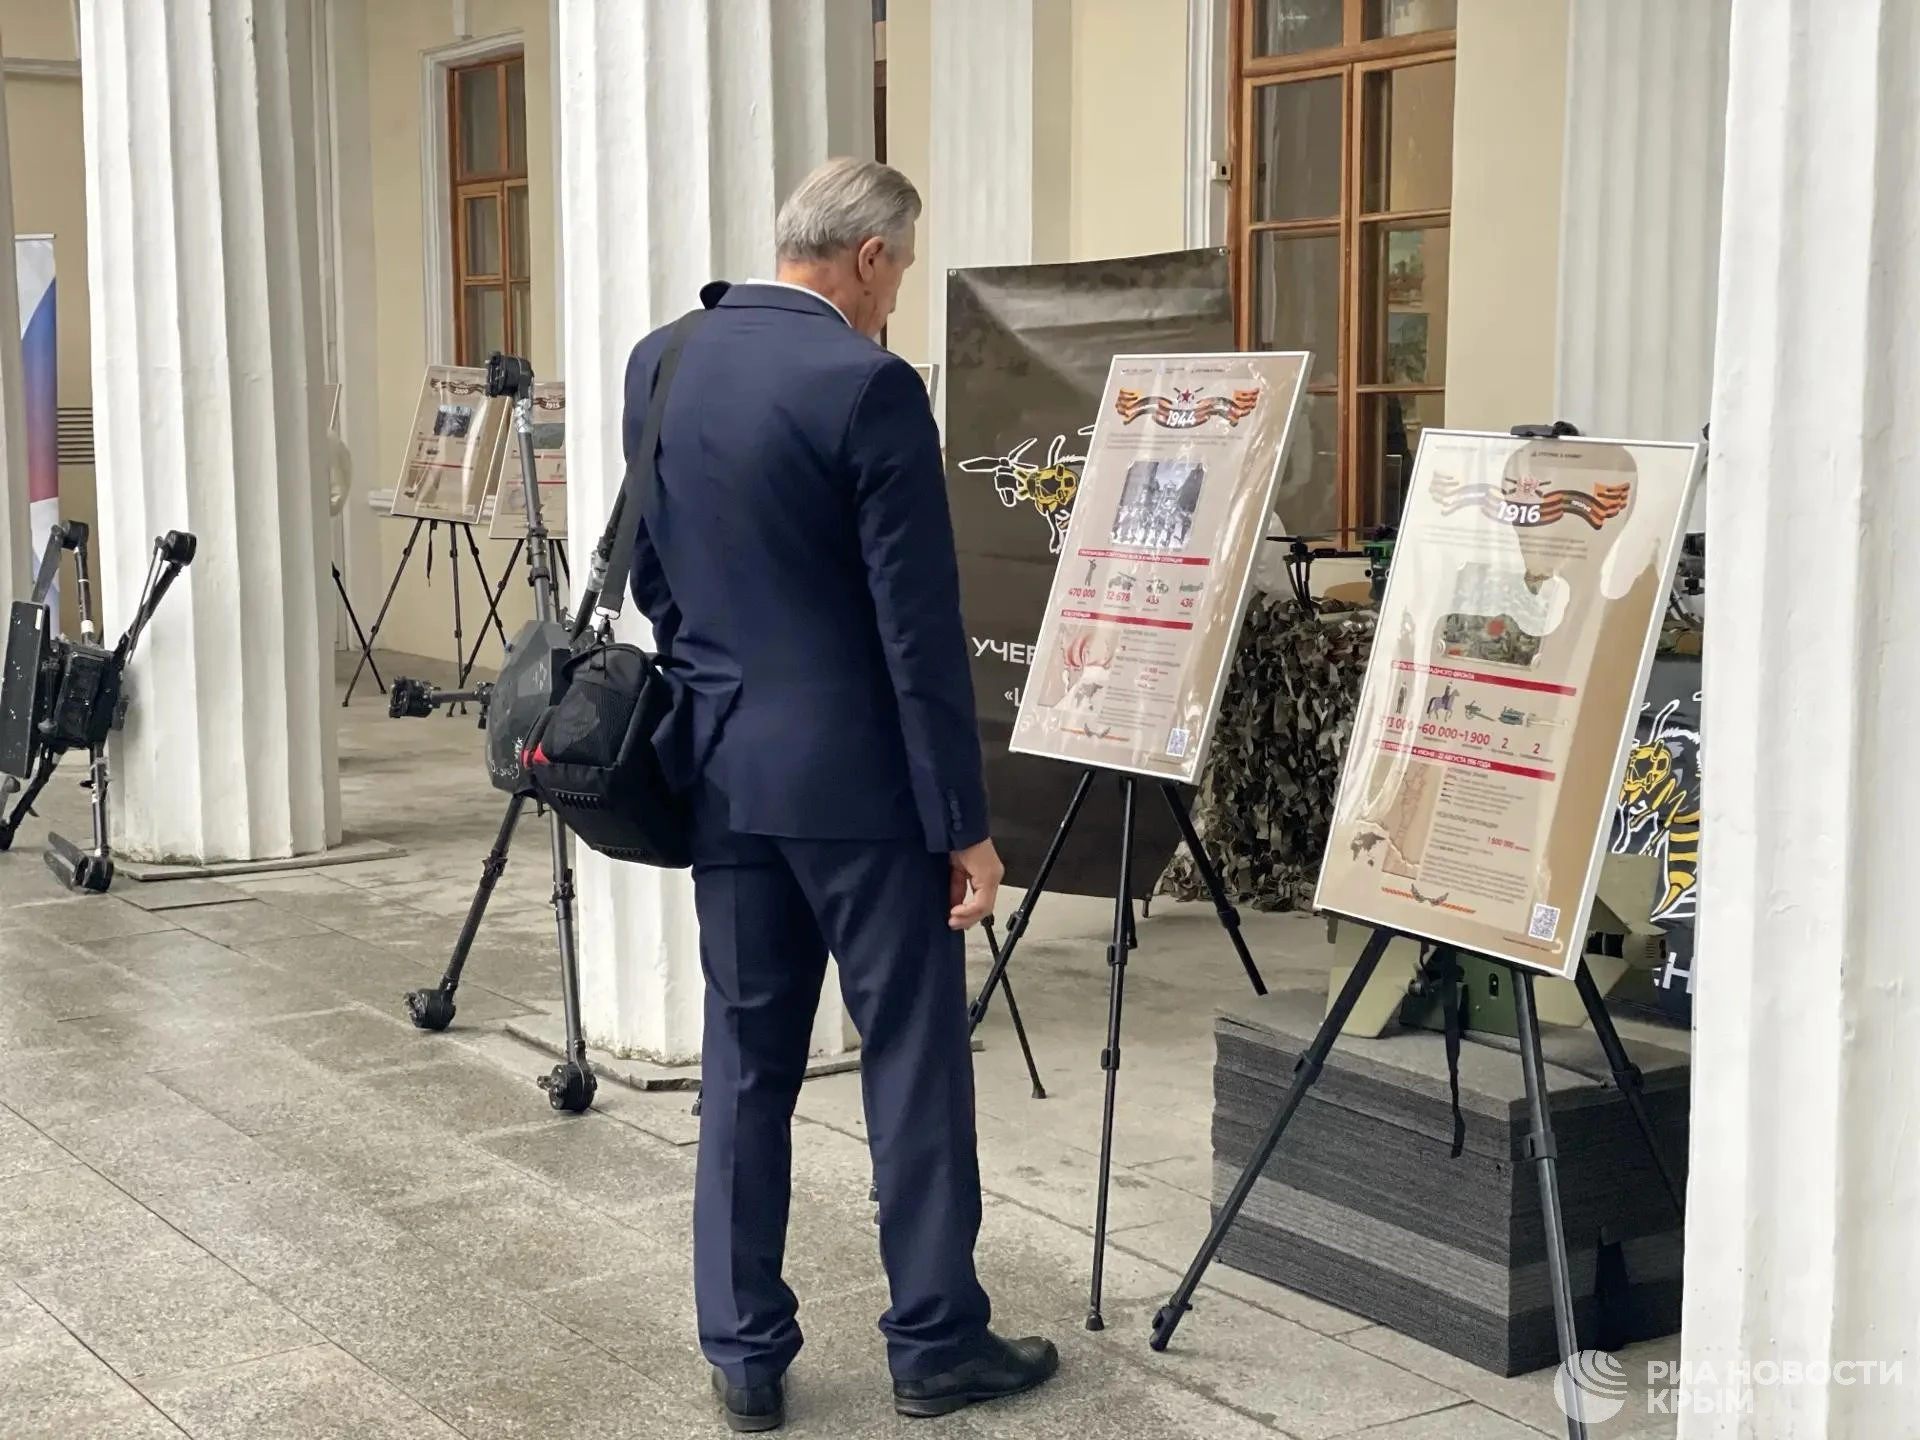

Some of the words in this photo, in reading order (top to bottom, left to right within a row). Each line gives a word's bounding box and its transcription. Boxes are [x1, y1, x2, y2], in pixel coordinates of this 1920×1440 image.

[1167, 411, 1196, 427] 1944
[1497, 501, 1541, 523] 1916
[1438, 726, 1458, 740] 000
[1470, 732, 1490, 746] 900
[1501, 738, 1509, 749] 2
[1533, 743, 1541, 755] 2
